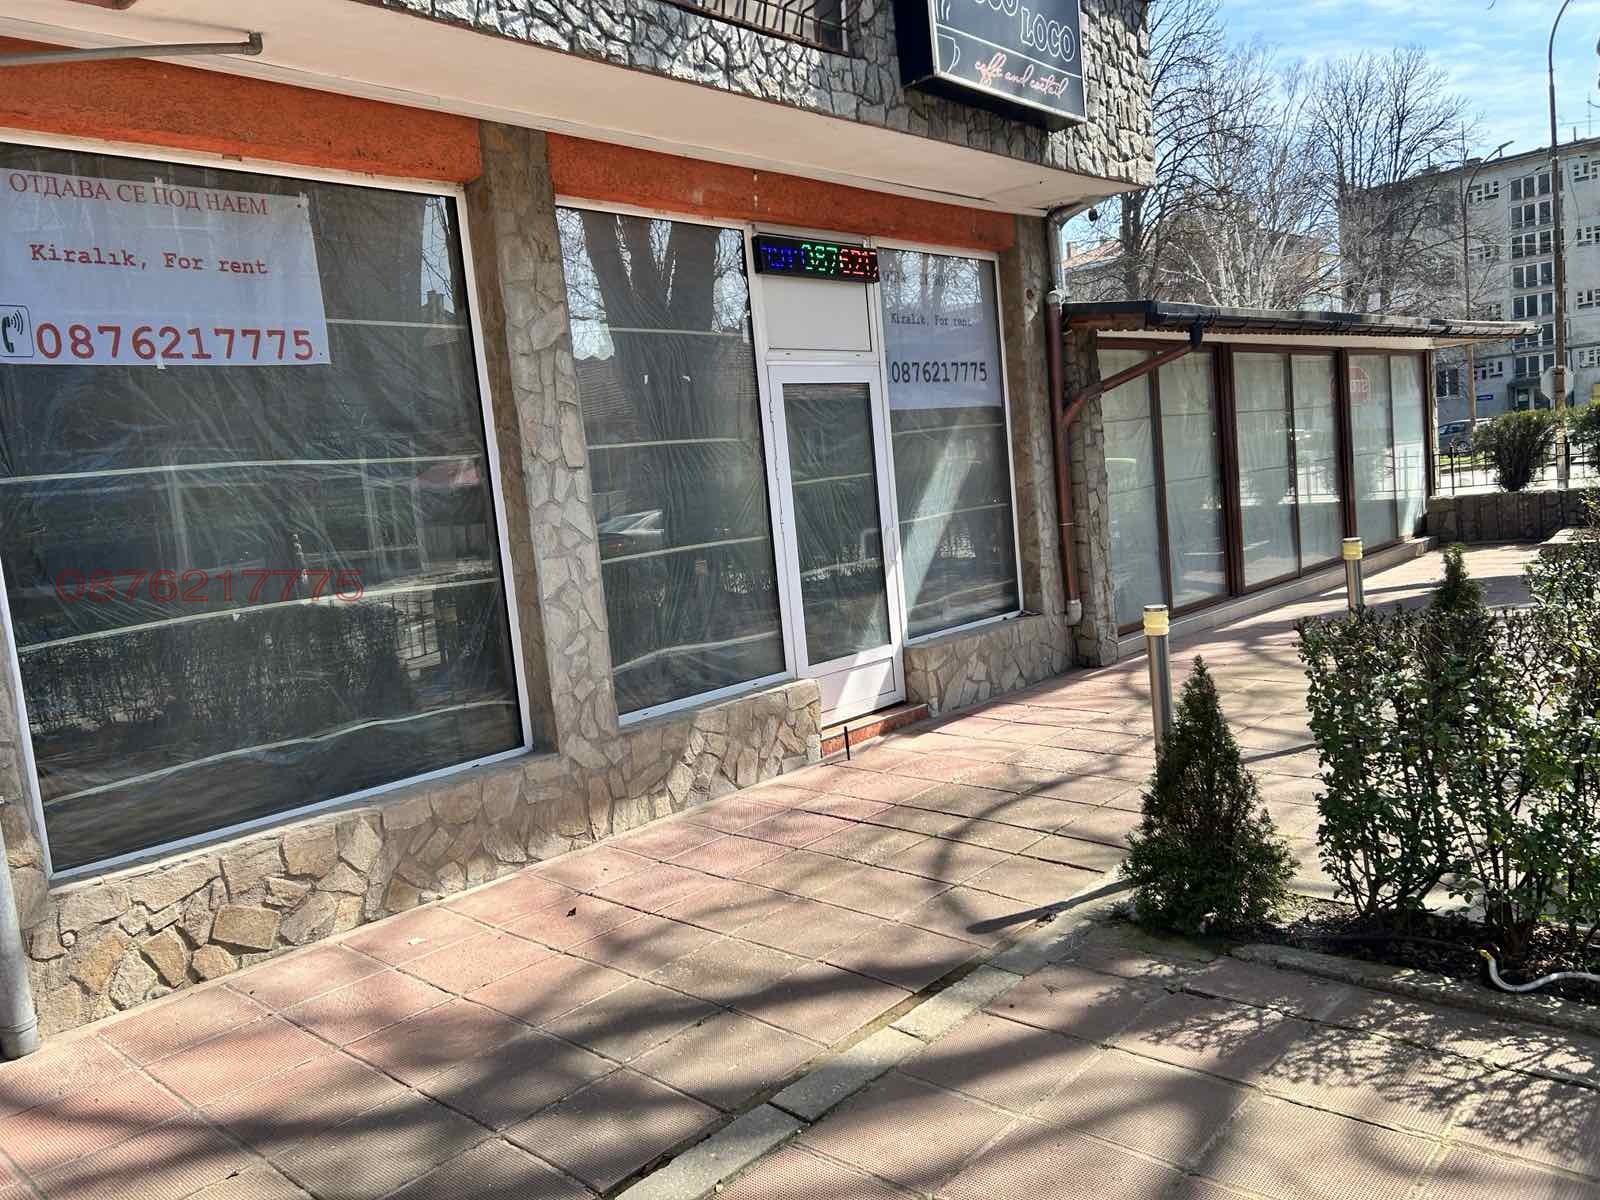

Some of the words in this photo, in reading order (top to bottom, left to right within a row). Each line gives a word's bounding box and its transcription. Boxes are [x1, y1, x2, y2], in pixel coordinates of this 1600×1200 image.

[1021, 7, 1075, 62] LOCO
[1004, 64, 1034, 87] and
[9, 173, 111, 200] ОТДАВА
[117, 184, 146, 203] СЕ
[152, 187, 200, 211] ПОД
[206, 193, 268, 215] НАЕМ
[163, 252, 204, 271] For
[218, 259, 269, 274] rent
[36, 322, 314, 361] 0876217775
[891, 360, 988, 383] 0876217775
